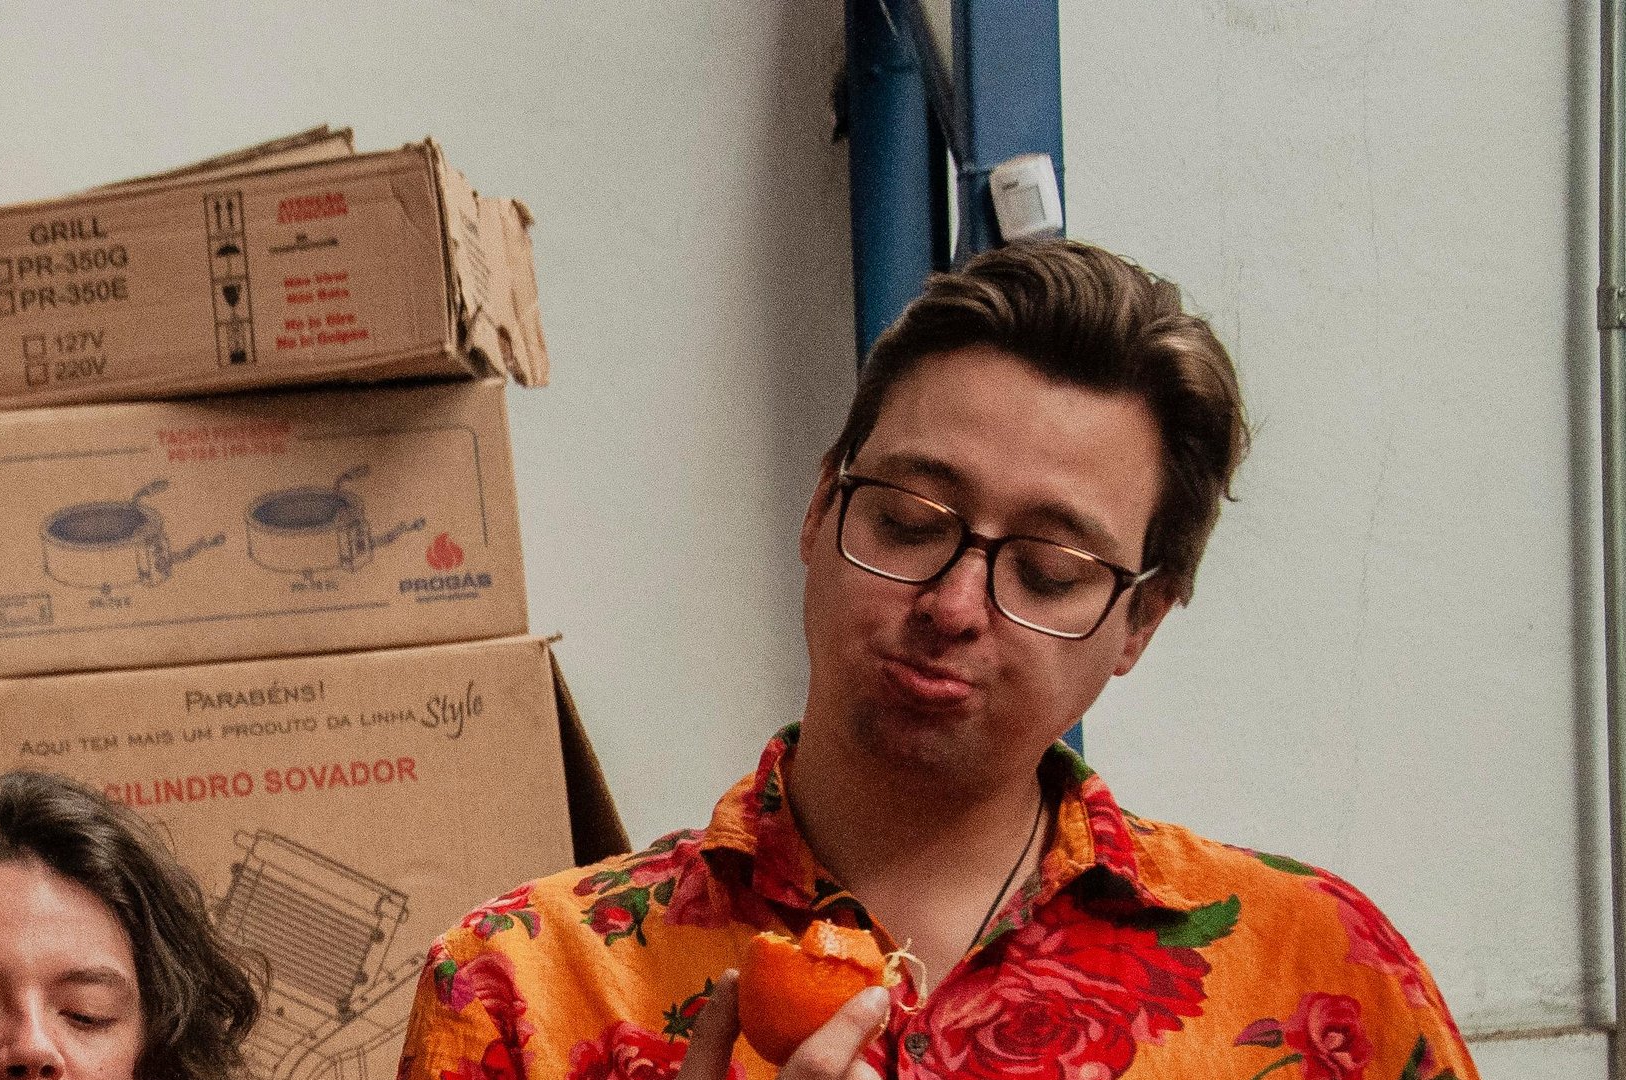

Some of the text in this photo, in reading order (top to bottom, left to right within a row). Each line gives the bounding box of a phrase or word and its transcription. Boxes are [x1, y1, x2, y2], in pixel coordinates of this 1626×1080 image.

[30, 217, 108, 246] GRILL
[54, 331, 105, 353] 127V
[56, 355, 107, 381] 220V
[185, 680, 325, 712] PARABÉNS!
[20, 680, 484, 757] AQUI TEM MAIS UM PRODUTO DA LINHA Style
[104, 756, 418, 807] CILINDRO SOVADOR
